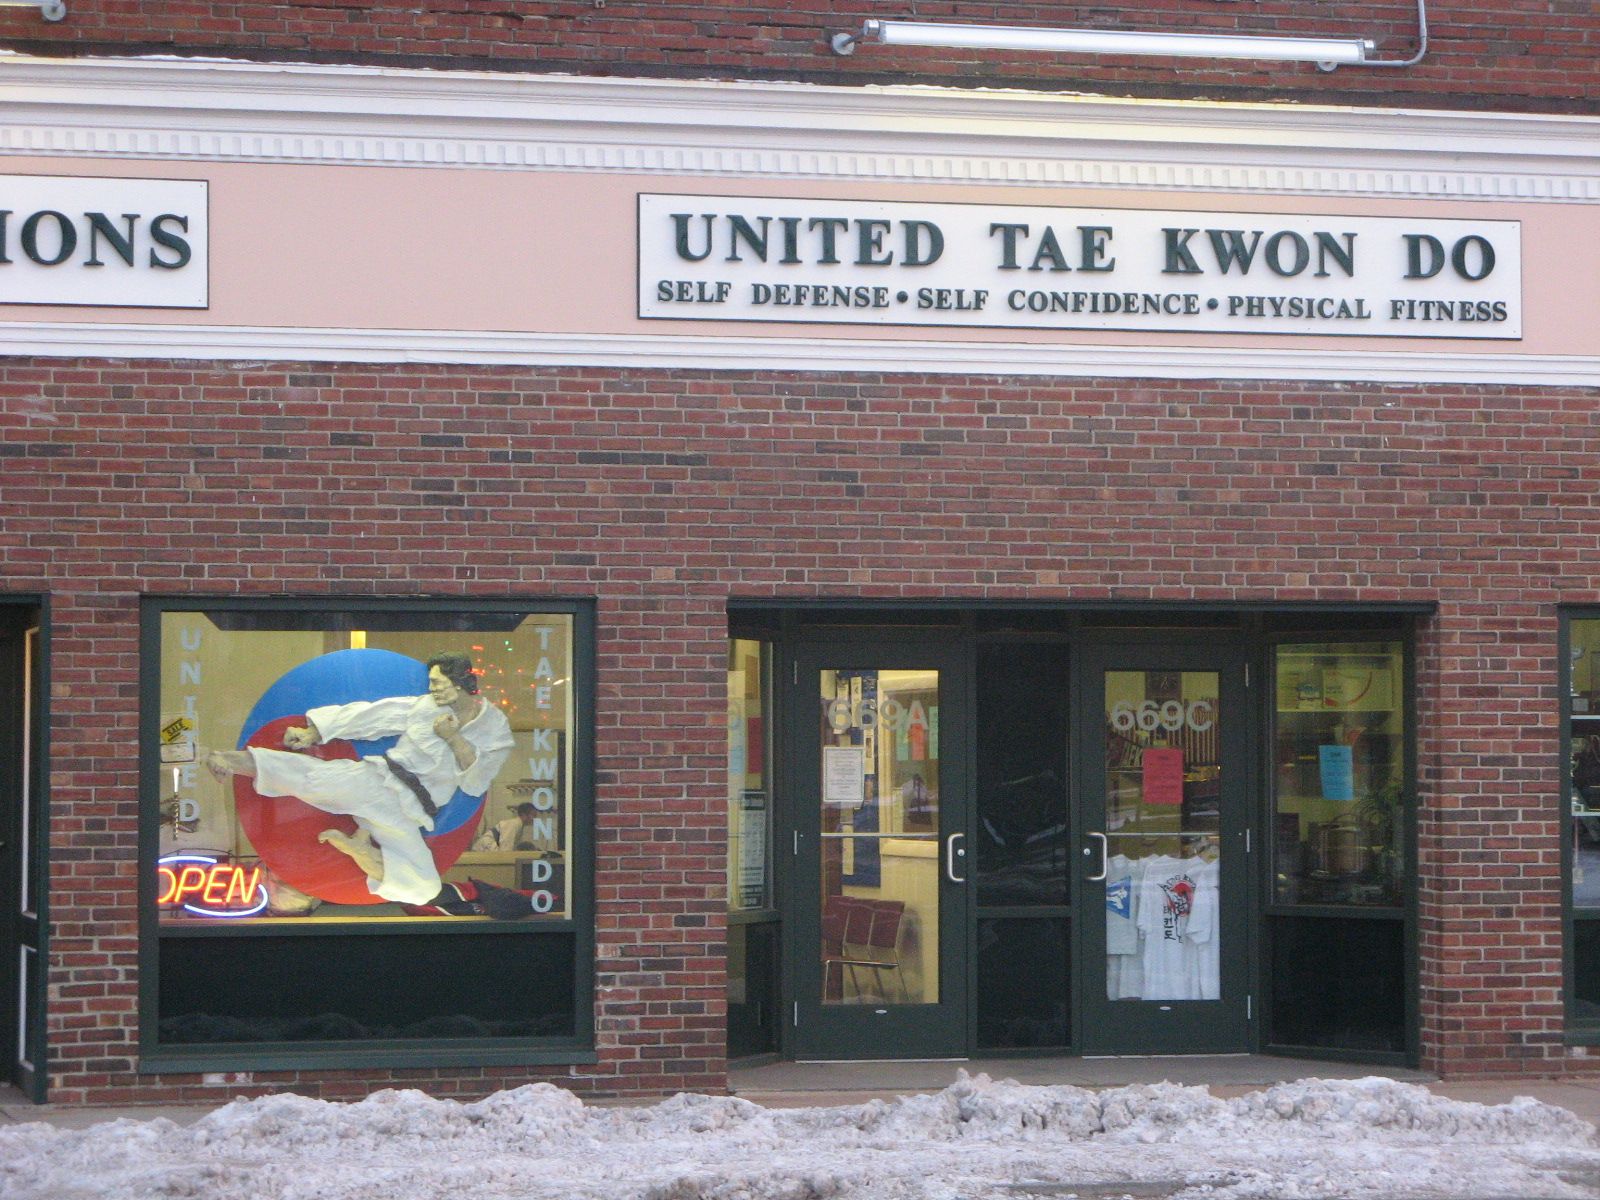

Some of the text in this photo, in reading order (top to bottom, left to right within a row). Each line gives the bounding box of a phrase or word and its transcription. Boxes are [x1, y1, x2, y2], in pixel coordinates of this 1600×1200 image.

[669, 213, 1496, 281] UNITED TAE KWON DO
[657, 280, 1508, 322] SELF DEFENSE SELF CONFIDENCE PHYSICAL FITNESS
[828, 699, 929, 732] 669A
[1111, 700, 1213, 731] 669C
